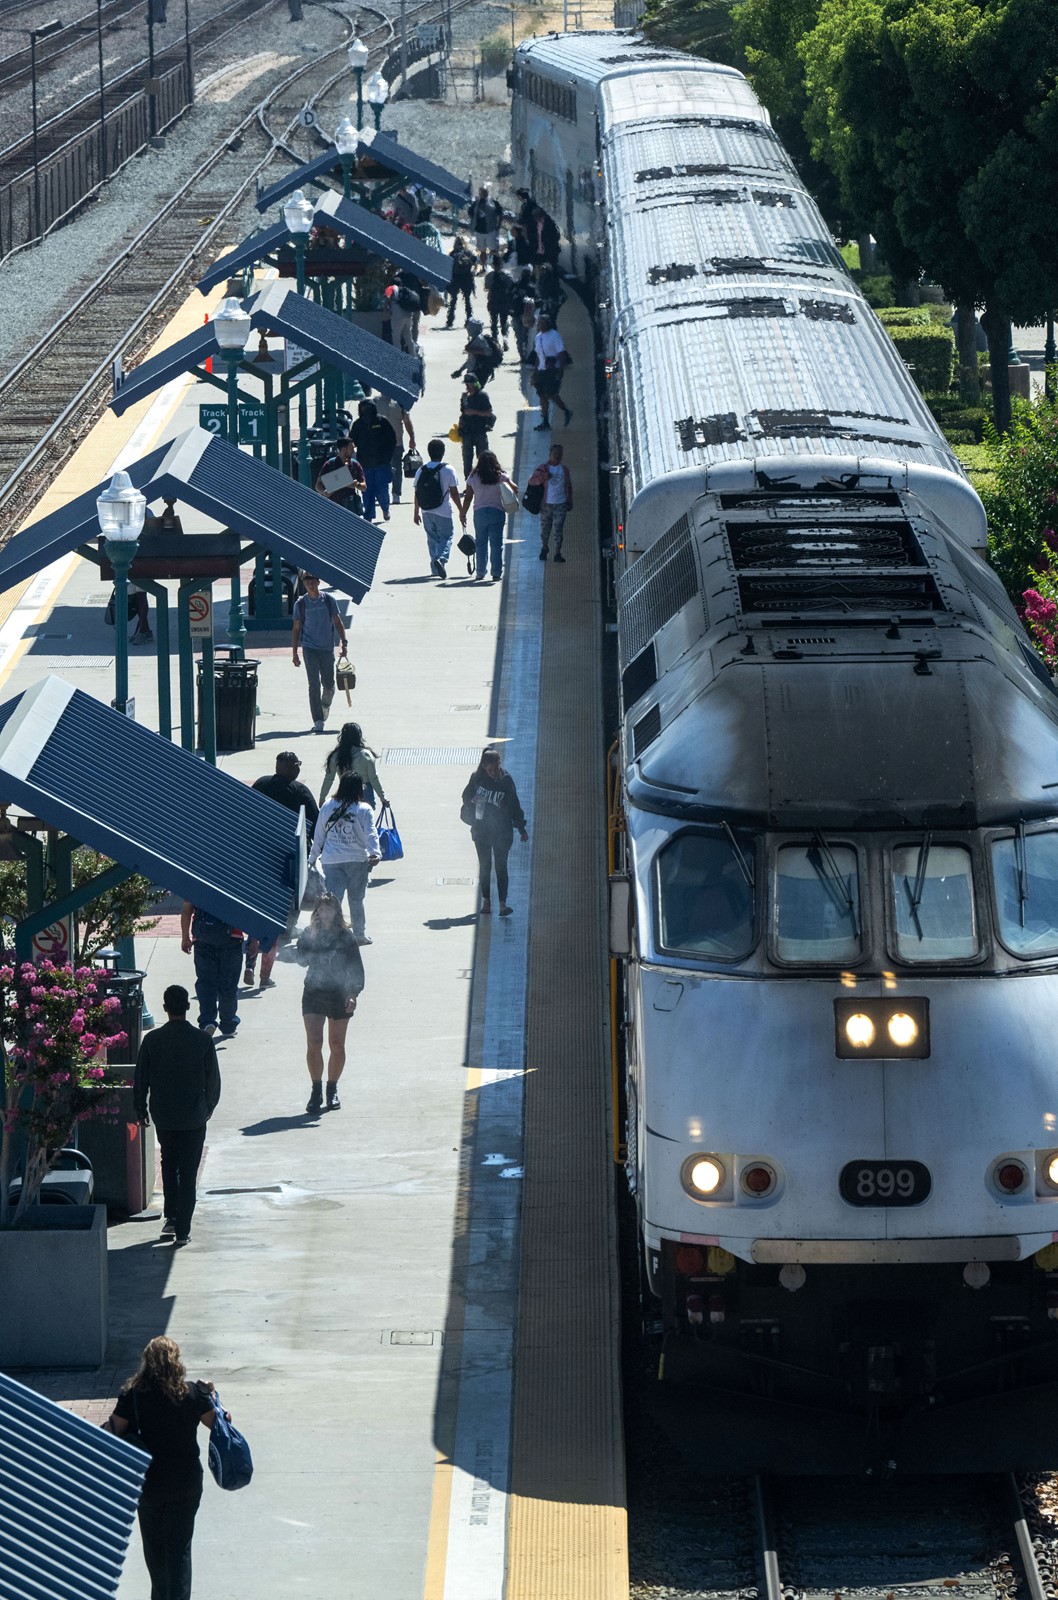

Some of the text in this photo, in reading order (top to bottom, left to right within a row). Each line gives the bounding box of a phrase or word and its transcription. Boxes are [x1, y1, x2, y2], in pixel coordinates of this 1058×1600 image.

[304, 111, 314, 125] D
[202, 409, 226, 417] Track
[207, 419, 221, 438] 2
[248, 418, 258, 437] 1
[857, 1169, 915, 1197] 899
[653, 1256, 659, 1274] F
